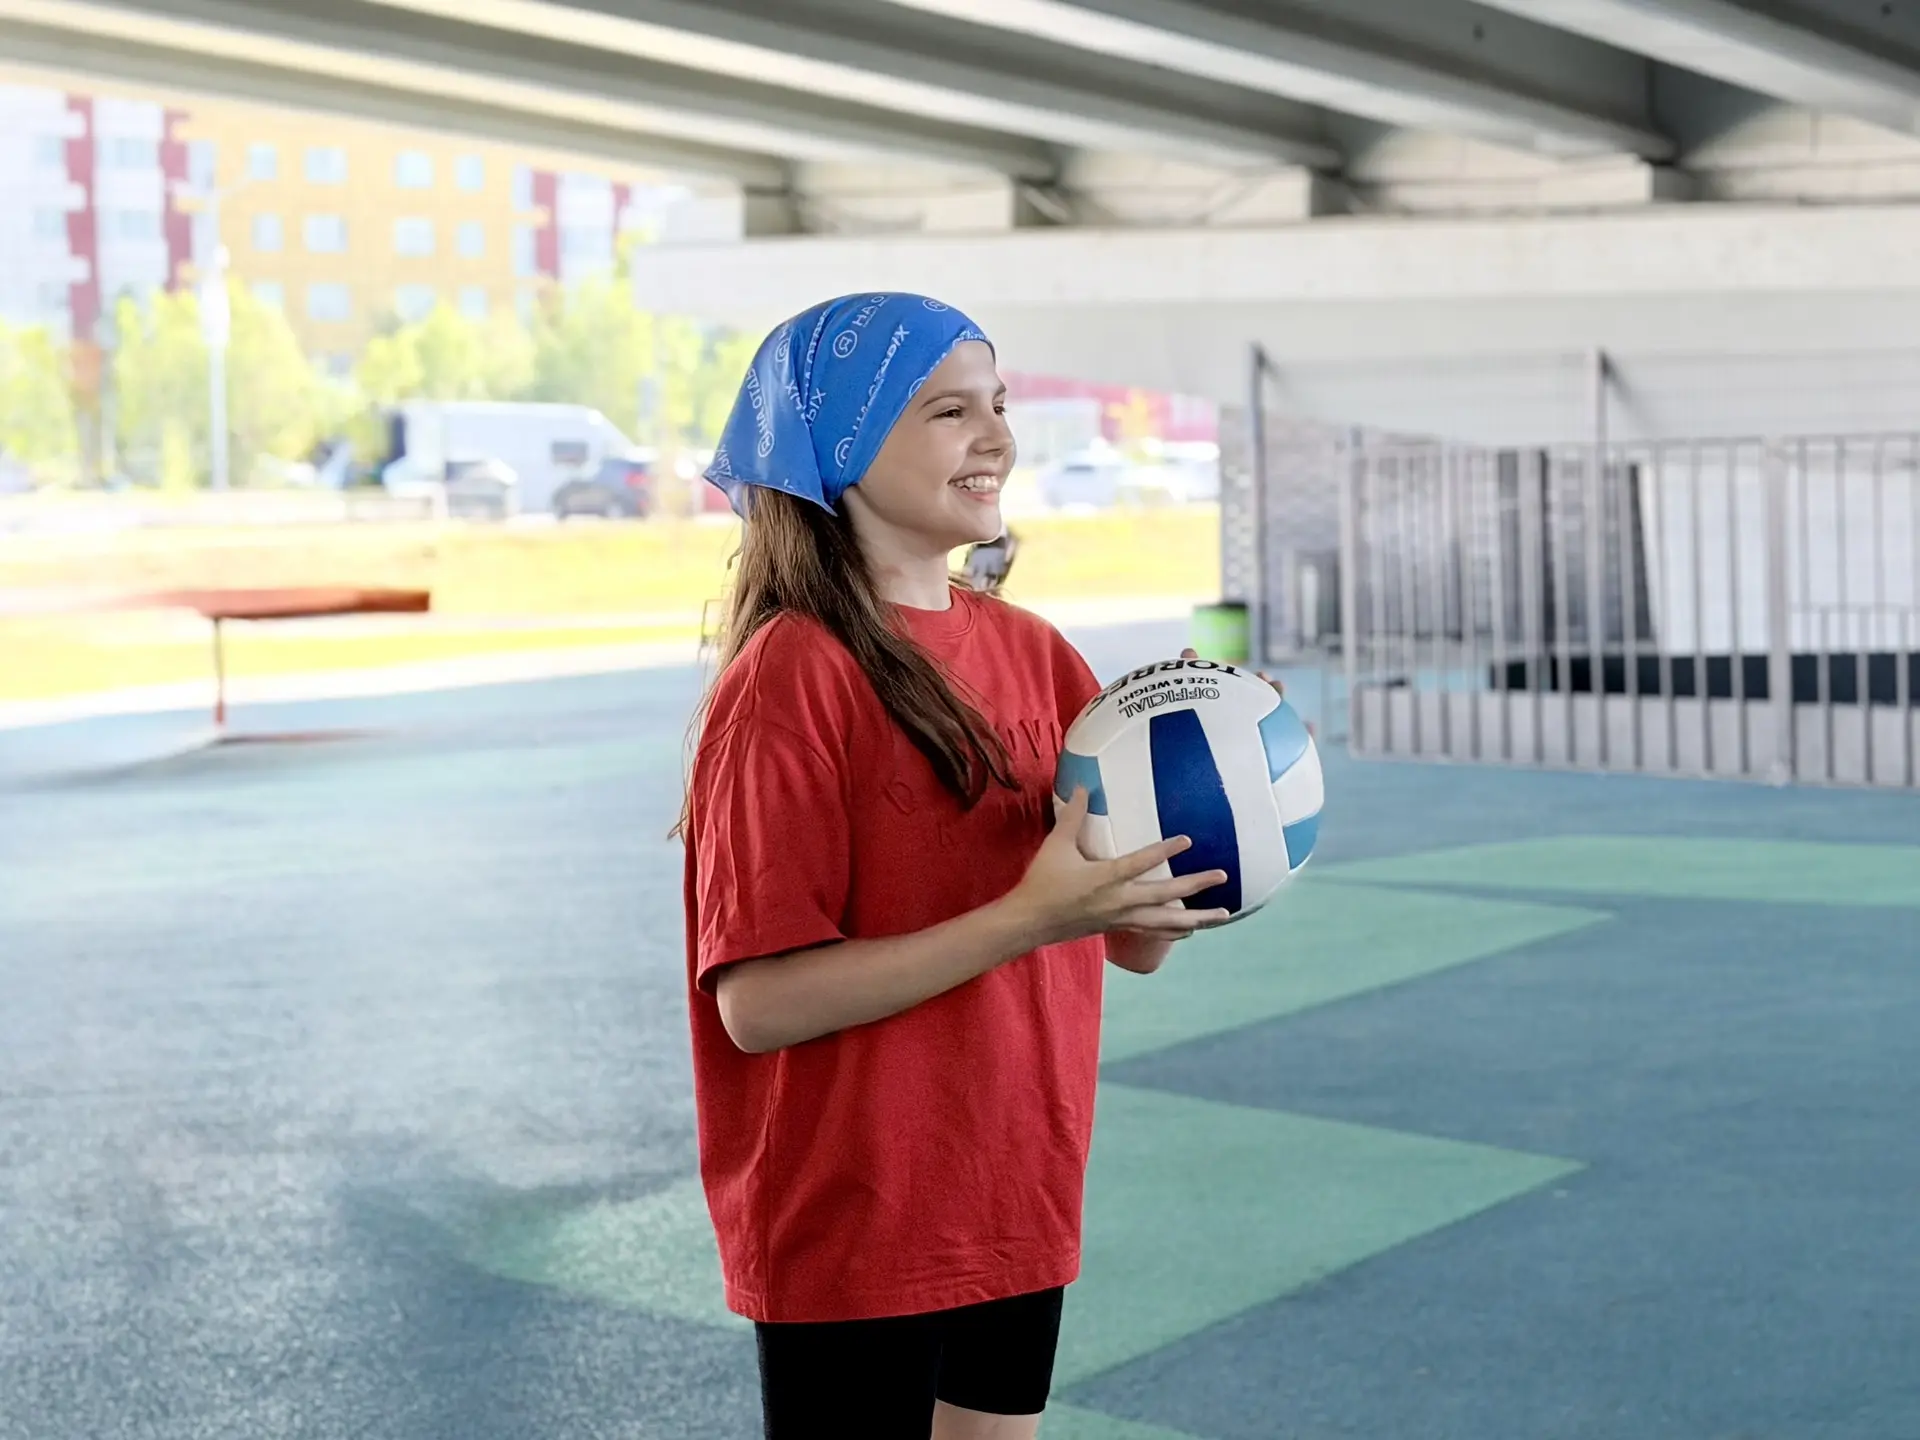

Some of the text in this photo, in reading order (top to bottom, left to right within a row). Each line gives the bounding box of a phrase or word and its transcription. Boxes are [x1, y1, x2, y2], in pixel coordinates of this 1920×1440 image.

[1117, 676, 1218, 706] SIZE & WEIGHT
[1118, 686, 1221, 719] OFFICIAL
